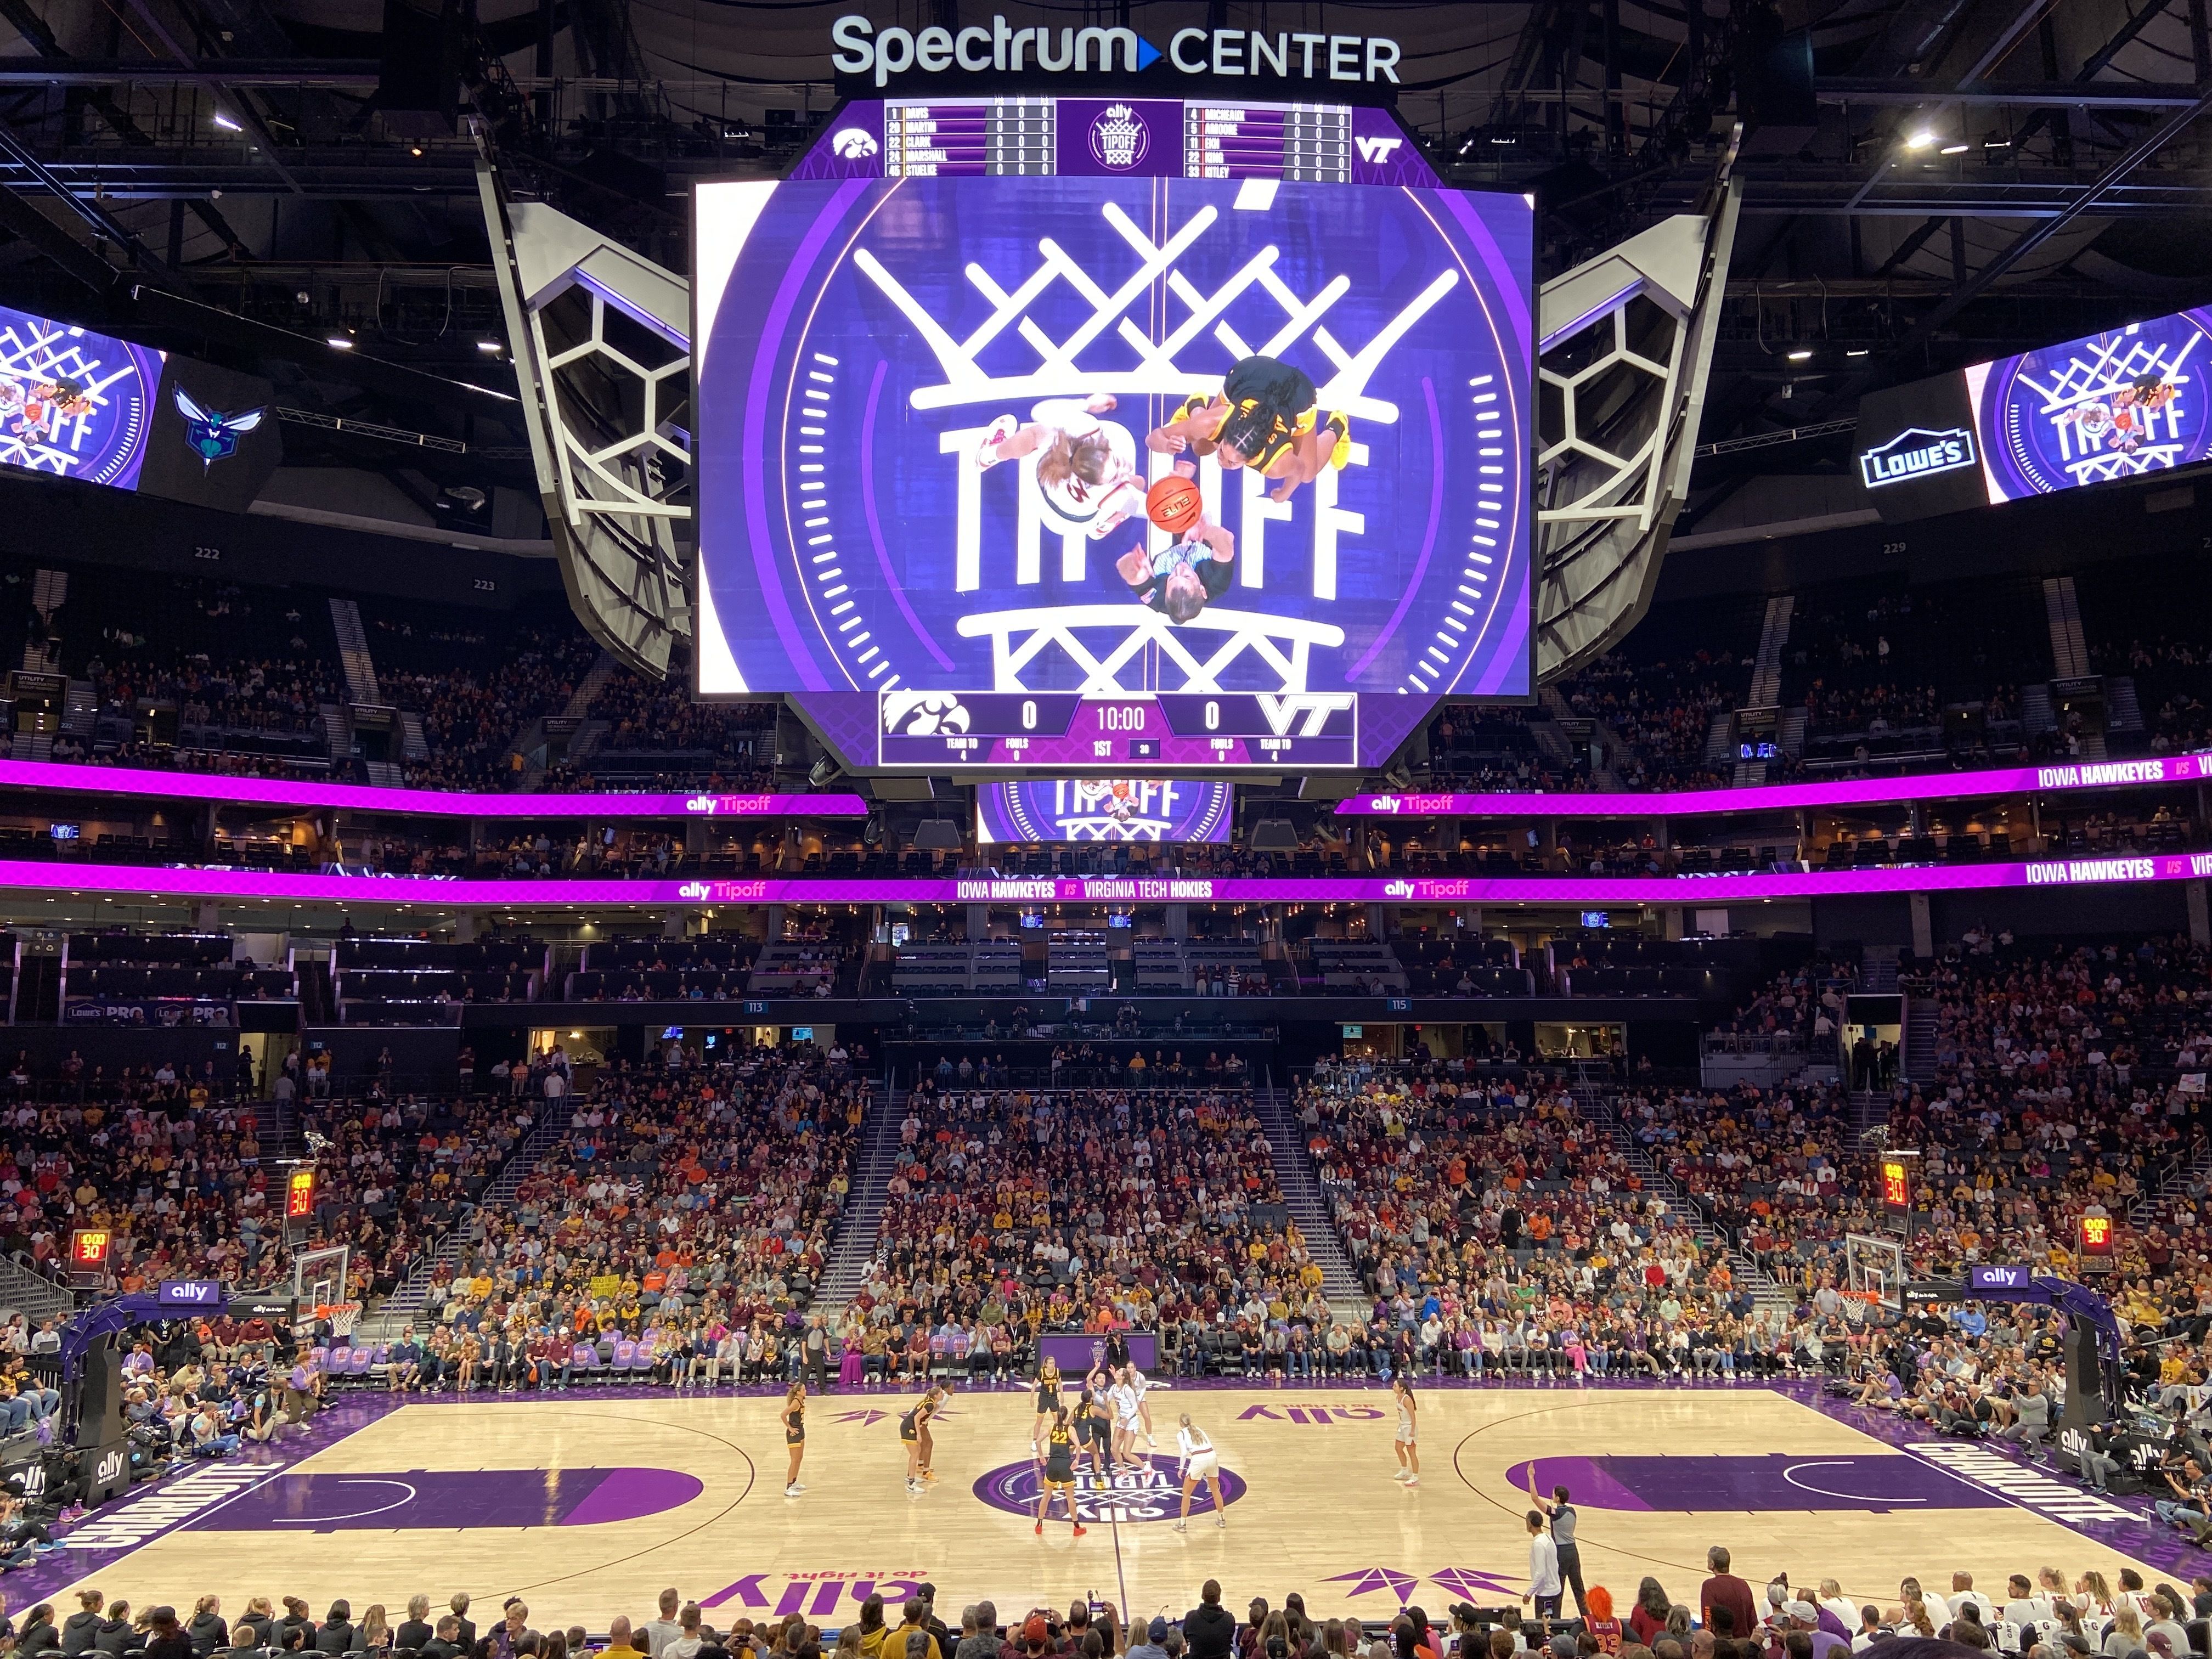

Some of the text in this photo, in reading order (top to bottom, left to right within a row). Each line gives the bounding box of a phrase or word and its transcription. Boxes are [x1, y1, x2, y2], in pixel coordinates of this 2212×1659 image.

[832, 15, 1401, 87] Spectrum CENTER
[892, 106, 1048, 120] 1 DAVIS 0 0 0
[1107, 104, 1132, 120] ally
[1190, 108, 1197, 120] 4
[1295, 112, 1300, 124] 0
[1316, 114, 1322, 125] 0
[1339, 115, 1344, 126] 0
[889, 122, 900, 133] 20
[997, 121, 1003, 132] 0
[1018, 121, 1024, 132] 0
[1042, 121, 1048, 132] 0
[1191, 122, 1344, 140] 5 AMOORE 0 0 0
[889, 135, 1048, 148] 22 CLARK 0 0 0
[1103, 135, 1136, 150] TIPOFF
[1190, 137, 1198, 149] 11
[1295, 140, 1300, 153] 0
[1316, 142, 1322, 154] 0
[1339, 143, 1344, 155] 0
[889, 149, 1048, 162] 24 MARSHALL 0 0 0
[1188, 151, 1344, 168] 22 KING 0 0 0
[889, 163, 1048, 176] 45 STUELKE 0 0 0
[1188, 166, 1344, 183] 33 KITLEY 0 0 0
[1873, 440, 1963, 479] LOWE'S
[1161, 496, 1191, 517] ELITE
[195, 547, 219, 560] 222
[1883, 543, 1906, 554] 229
[474, 579, 495, 591] 223
[1023, 701, 1036, 729] 0
[1097, 707, 1144, 730] 10:00
[1205, 701, 1219, 730] 0
[1256, 694, 1355, 736] VT
[946, 738, 978, 749] TEAM TO
[1006, 738, 1029, 749] FOULS
[1093, 741, 1111, 756] 1ST
[1140, 744, 1149, 754] 30
[1211, 738, 1233, 749] FOULS
[1260, 738, 1291, 750] TEAM TO
[961, 750, 967, 761] 4
[1013, 750, 1020, 761] 0
[1218, 751, 1224, 761] 0
[1272, 751, 1278, 761] 4
[2038, 761, 2190, 788] IOWA HAWKEYES VS
[686, 796, 771, 814] ally Tipoff
[1372, 795, 1453, 814] ally Tipoff
[2026, 859, 2182, 883] IOWA HAWKEYES VS
[679, 882, 766, 901] ally Tipoff
[957, 881, 1212, 899] IOWA HAWKEYES VS VIRGINIA TECH HOKIES
[1385, 880, 1469, 900] ally Tipoff
[749, 1002, 763, 1013] 113
[1393, 1000, 1407, 1010] 115
[107, 1007, 144, 1019] PRO
[1887, 1177, 1903, 1204] 30
[290, 1189, 309, 1214] 30
[2084, 1218, 2108, 1231] 10:00
[81, 1233, 105, 1246] 10:00
[2087, 1230, 2103, 1243] 30
[82, 1245, 99, 1259] 30
[1983, 1268, 2017, 1285] ally
[171, 1283, 207, 1301] ally
[1906, 1291, 1918, 1299] ally
[253, 1305, 266, 1313] ally
[1048, 1385, 1053, 1393] 1
[1235, 1404, 1386, 1424] ally
[1052, 1431, 1068, 1443] 22
[2061, 1427, 2087, 1452] ally
[98, 1450, 124, 1479] ally
[1904, 1443, 2149, 1522] CHARLOTTE
[64, 1463, 285, 1548] CHARLOTTE
[782, 1570, 928, 1581] right. it do
[698, 1574, 927, 1616] ally
[1596, 1634, 1620, 1653] 33
